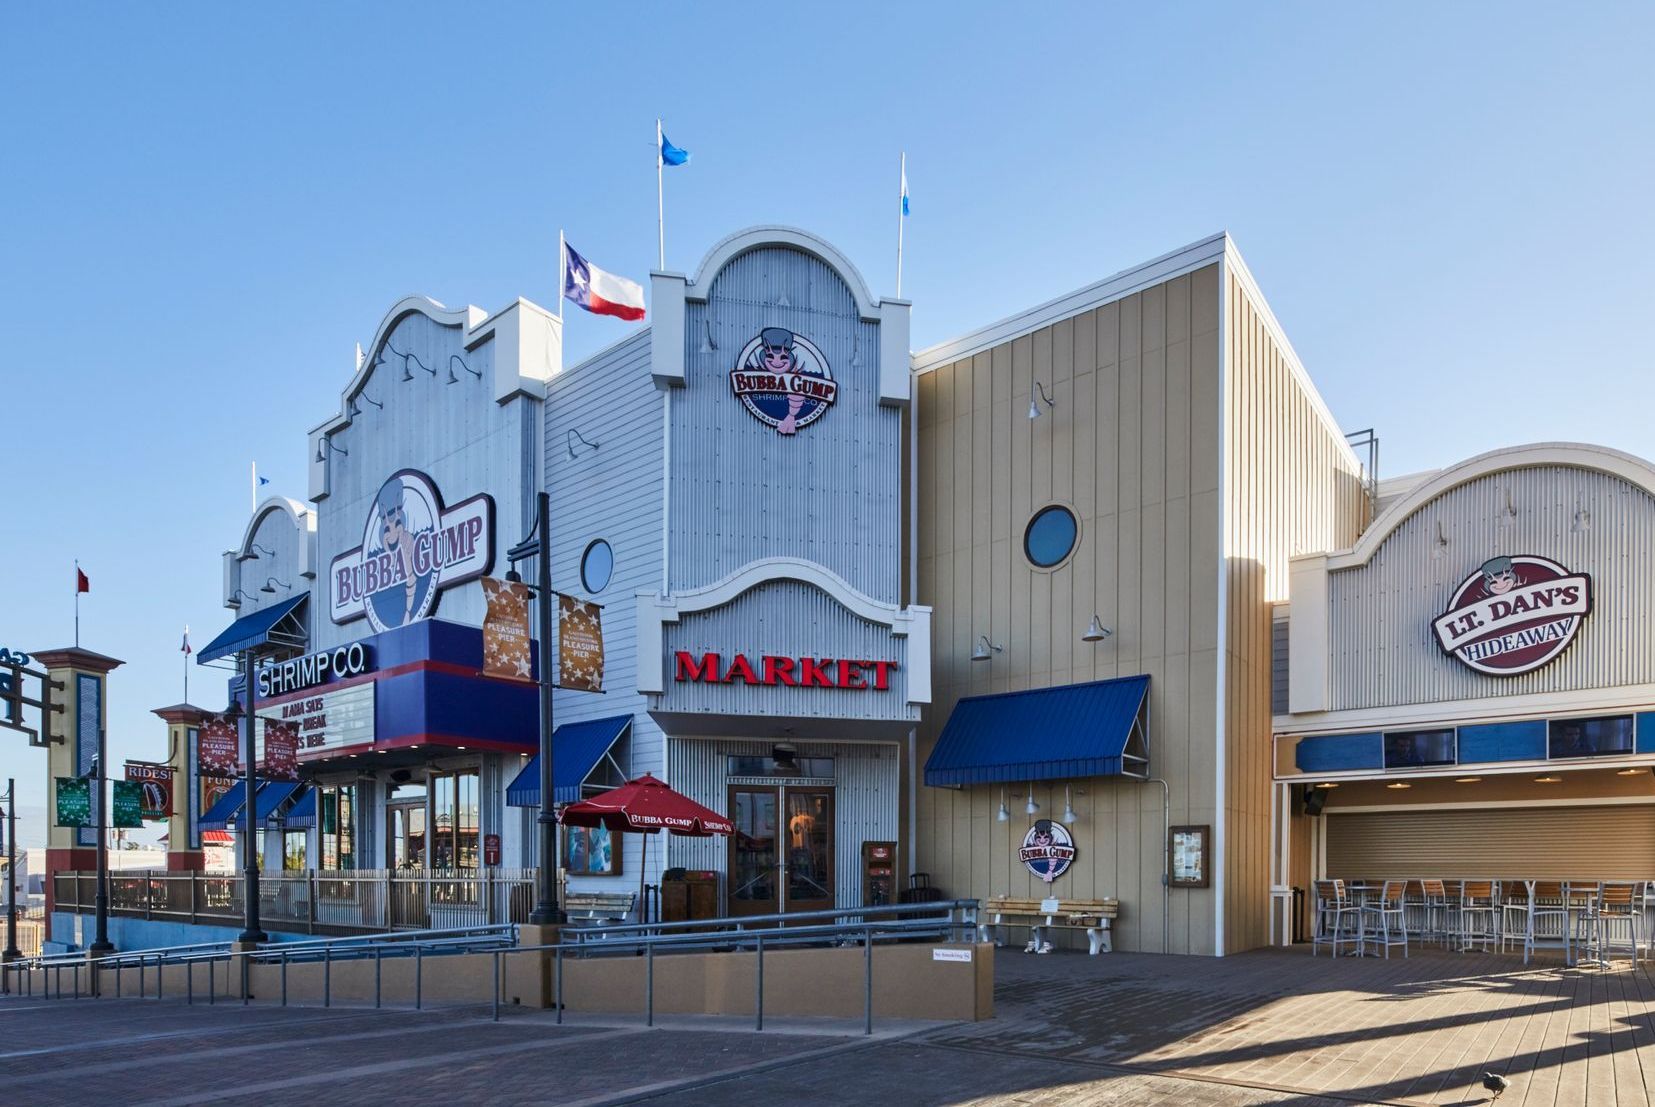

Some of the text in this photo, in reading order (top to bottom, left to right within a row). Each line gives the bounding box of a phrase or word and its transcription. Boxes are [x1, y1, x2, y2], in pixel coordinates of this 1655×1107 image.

[734, 373, 834, 398] BUBBA GUMP
[336, 516, 483, 607] BUBBA GUMP
[1445, 586, 1580, 640] LT. DAN'S
[487, 623, 525, 636] PLEASURE
[498, 633, 516, 642] PIER
[1466, 619, 1570, 661] HIDEAWAY
[562, 640, 600, 652] PLEASURE
[573, 650, 589, 658] PIER
[259, 642, 365, 697] SHRIMP CO.
[674, 651, 897, 690] MARKET
[202, 743, 235, 751] PLEASURE
[267, 747, 293, 755] PLEASURE
[129, 767, 172, 779] RIDES!
[631, 814, 692, 827] BUBBA GUMP
[1021, 847, 1072, 859] BUBBA GUMP
